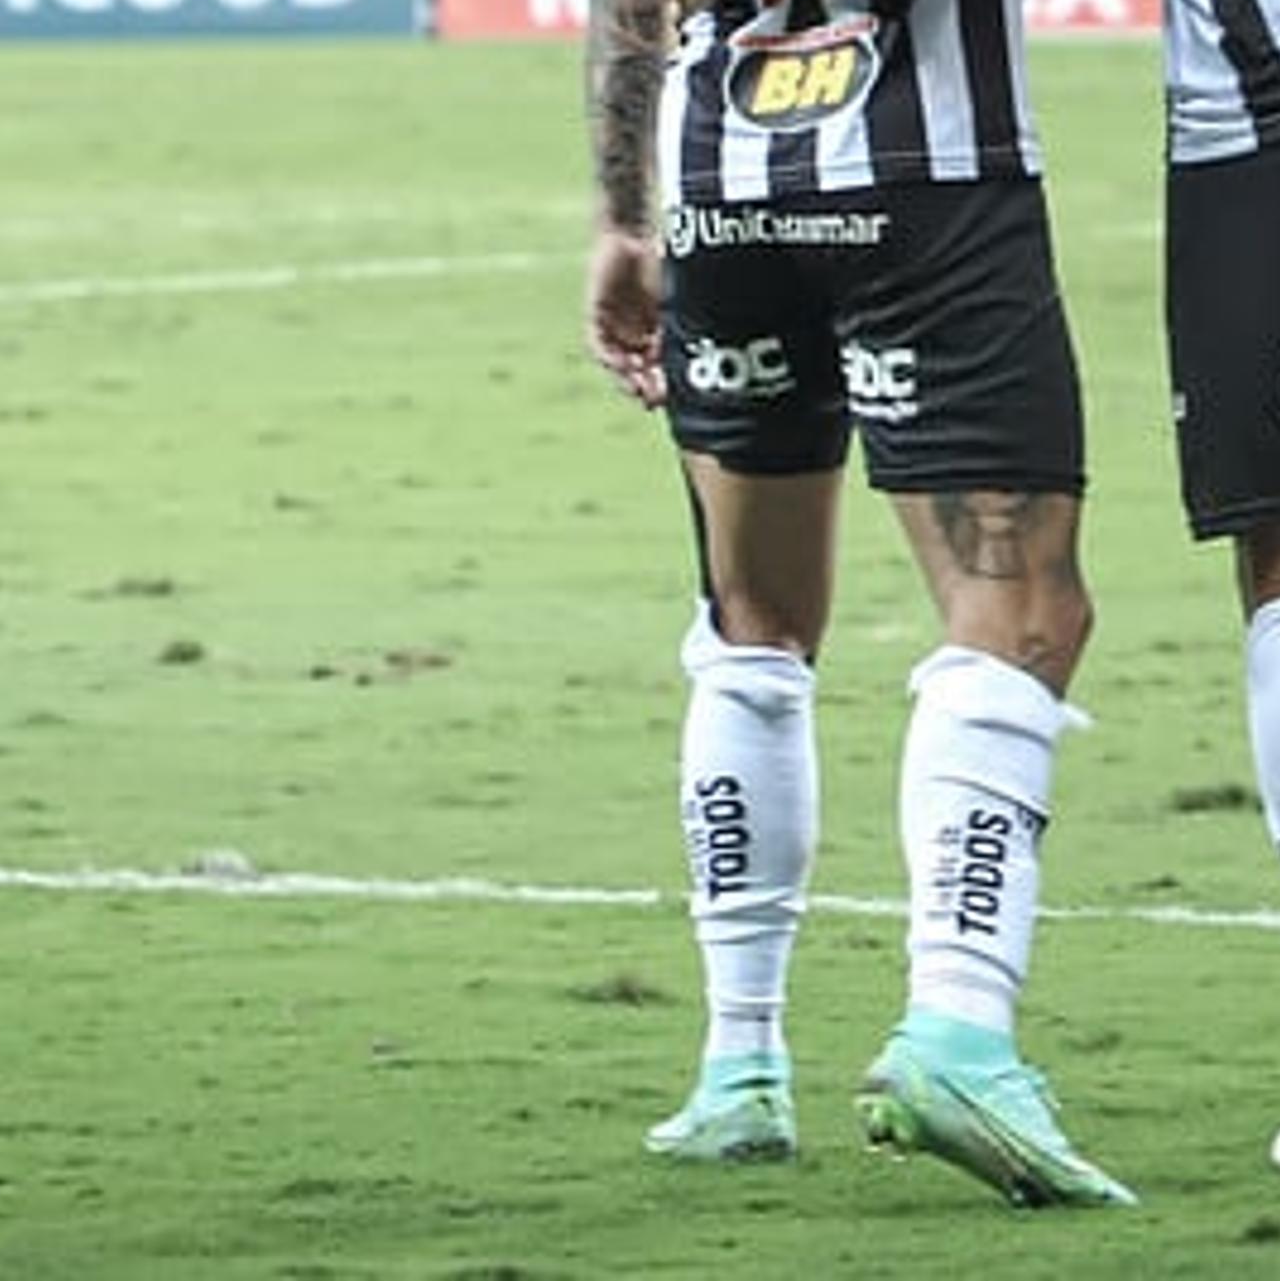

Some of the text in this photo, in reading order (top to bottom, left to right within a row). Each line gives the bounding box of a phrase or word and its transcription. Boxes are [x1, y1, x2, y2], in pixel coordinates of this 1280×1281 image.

[753, 46, 858, 116] BH
[695, 775, 750, 902] TODOS
[954, 808, 1012, 937] TODOS
